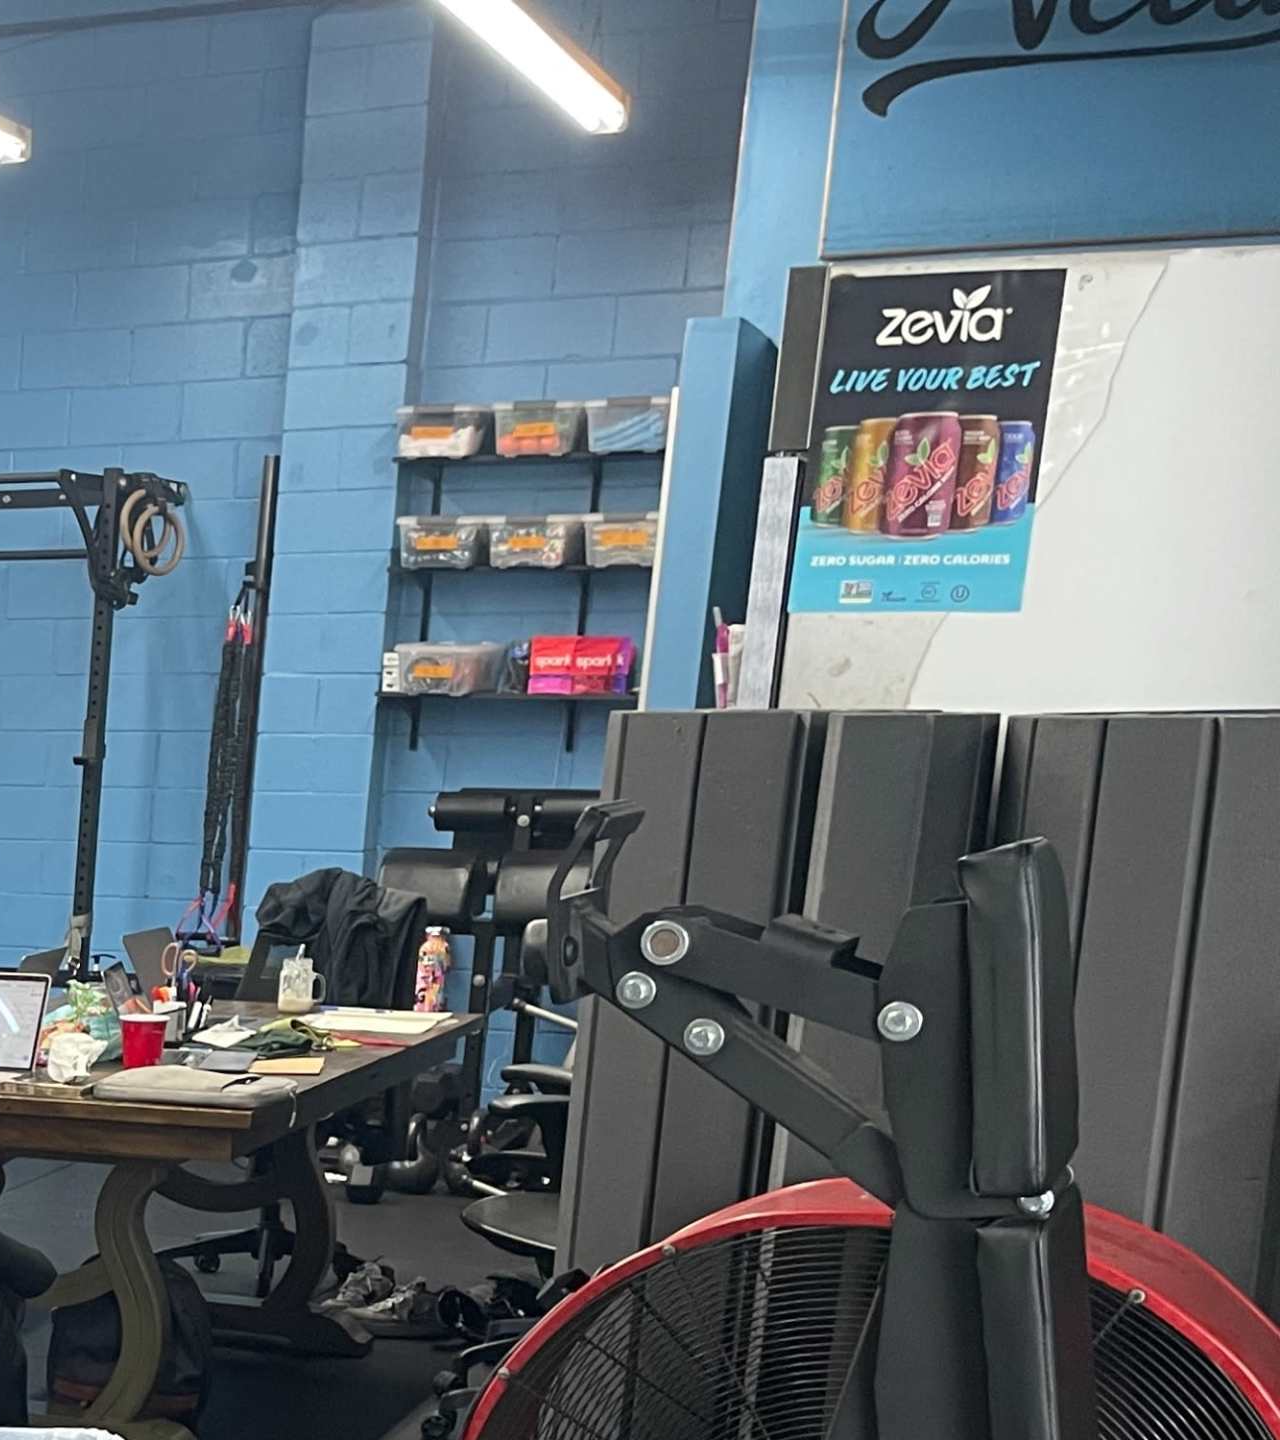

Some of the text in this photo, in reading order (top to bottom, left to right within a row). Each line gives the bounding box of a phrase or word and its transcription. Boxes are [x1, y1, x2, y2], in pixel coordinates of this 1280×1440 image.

[830, 361, 1040, 395] LIVE YOUR BEST
[810, 553, 1011, 567] ZERO SUGAR ZERO CALORIES
